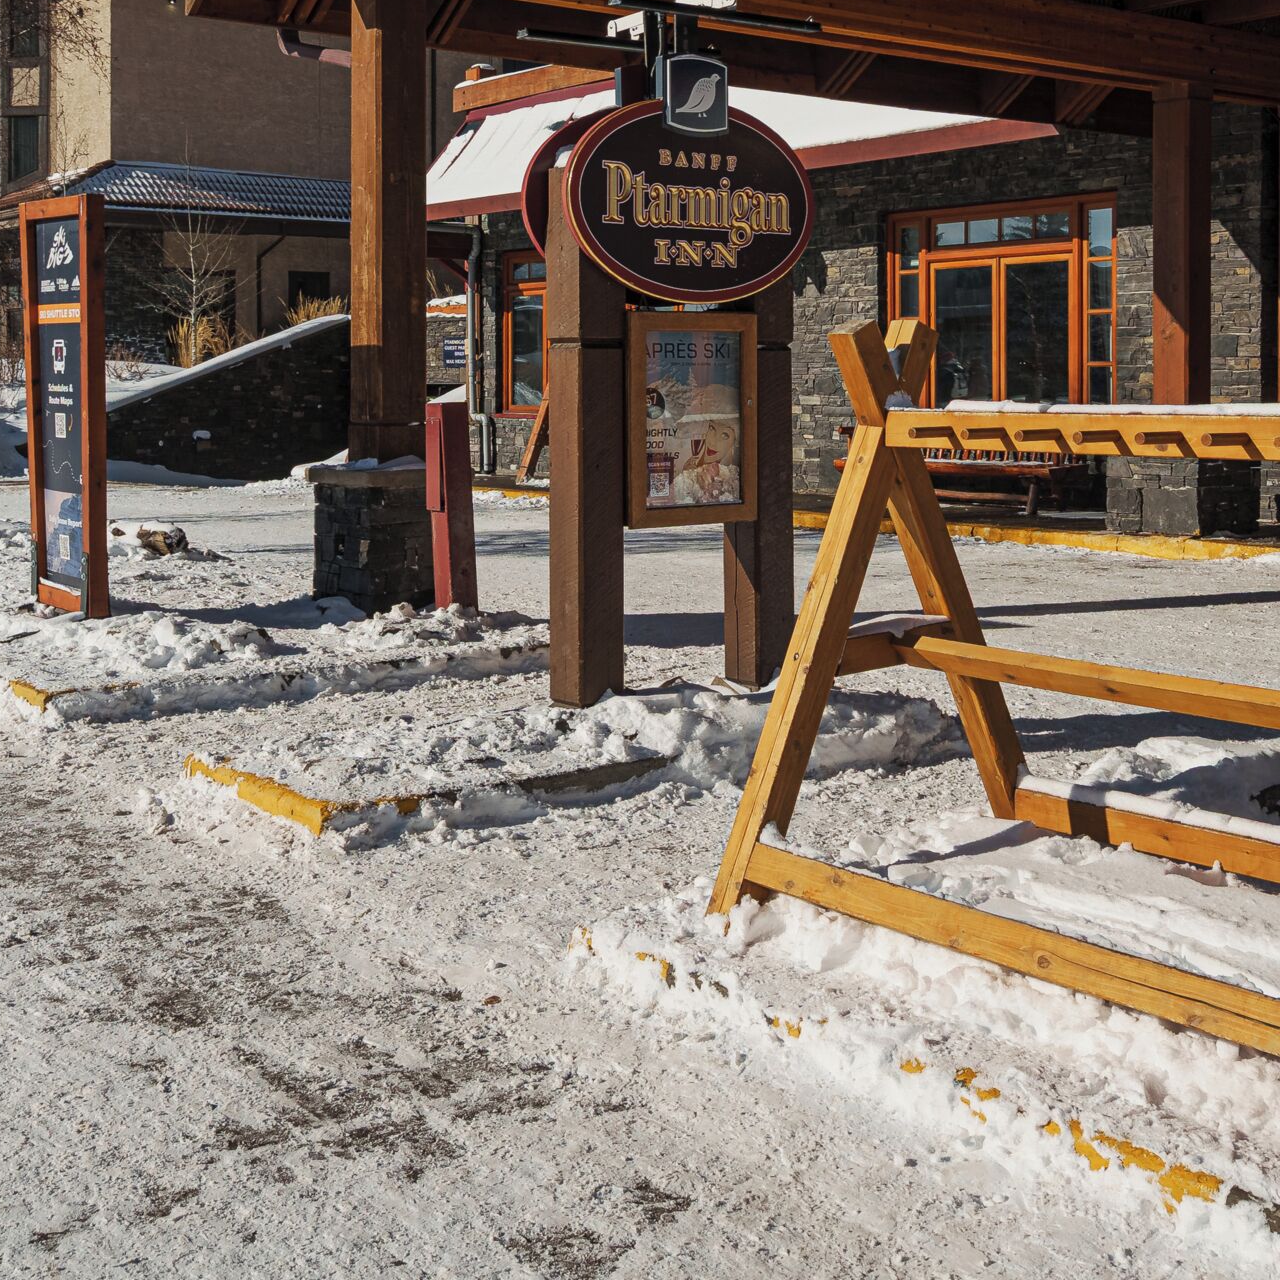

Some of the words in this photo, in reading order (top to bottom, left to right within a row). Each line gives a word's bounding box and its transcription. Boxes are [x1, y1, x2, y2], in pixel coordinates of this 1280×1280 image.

[659, 149, 737, 171] BANFF
[602, 160, 791, 247] Ptarmigan
[47, 309, 68, 318] SHUTTLE
[69, 308, 80, 317] STO
[704, 343, 730, 359] SKI
[646, 441, 665, 449] OOD
